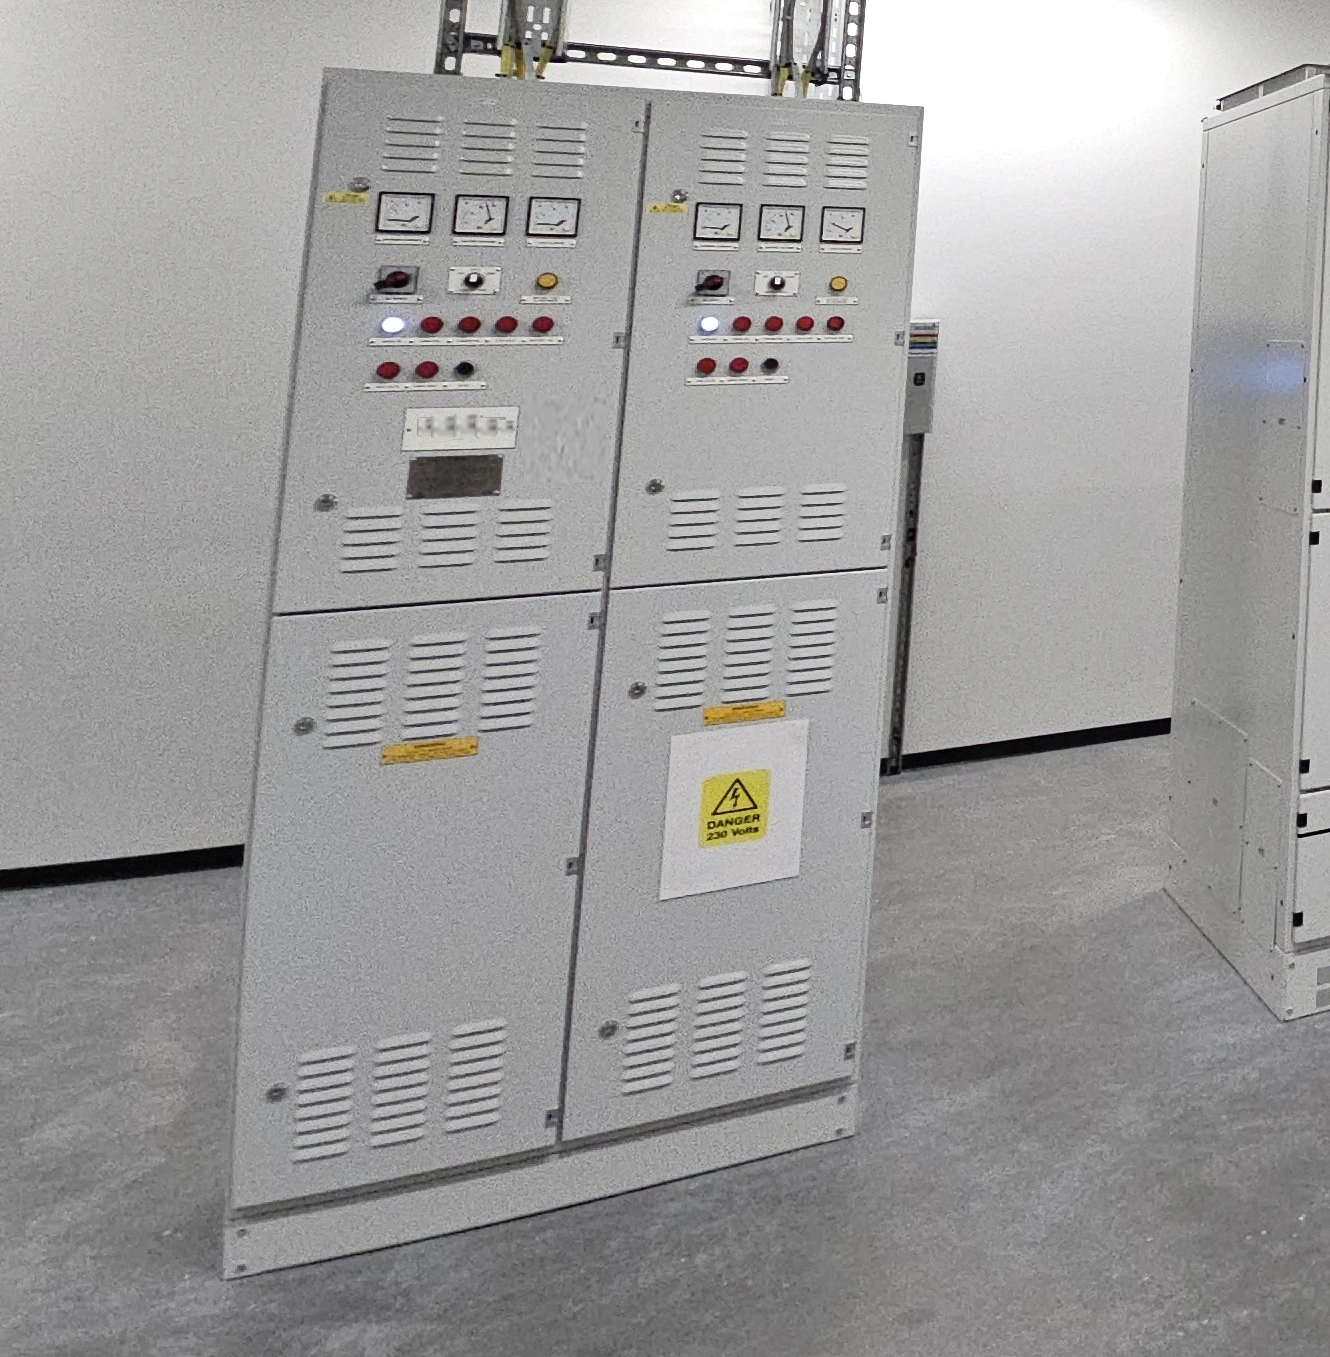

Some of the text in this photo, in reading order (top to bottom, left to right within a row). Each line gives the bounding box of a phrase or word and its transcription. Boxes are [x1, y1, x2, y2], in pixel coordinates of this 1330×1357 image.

[707, 813, 760, 830] DANGER
[706, 826, 759, 841] 230 Volts
